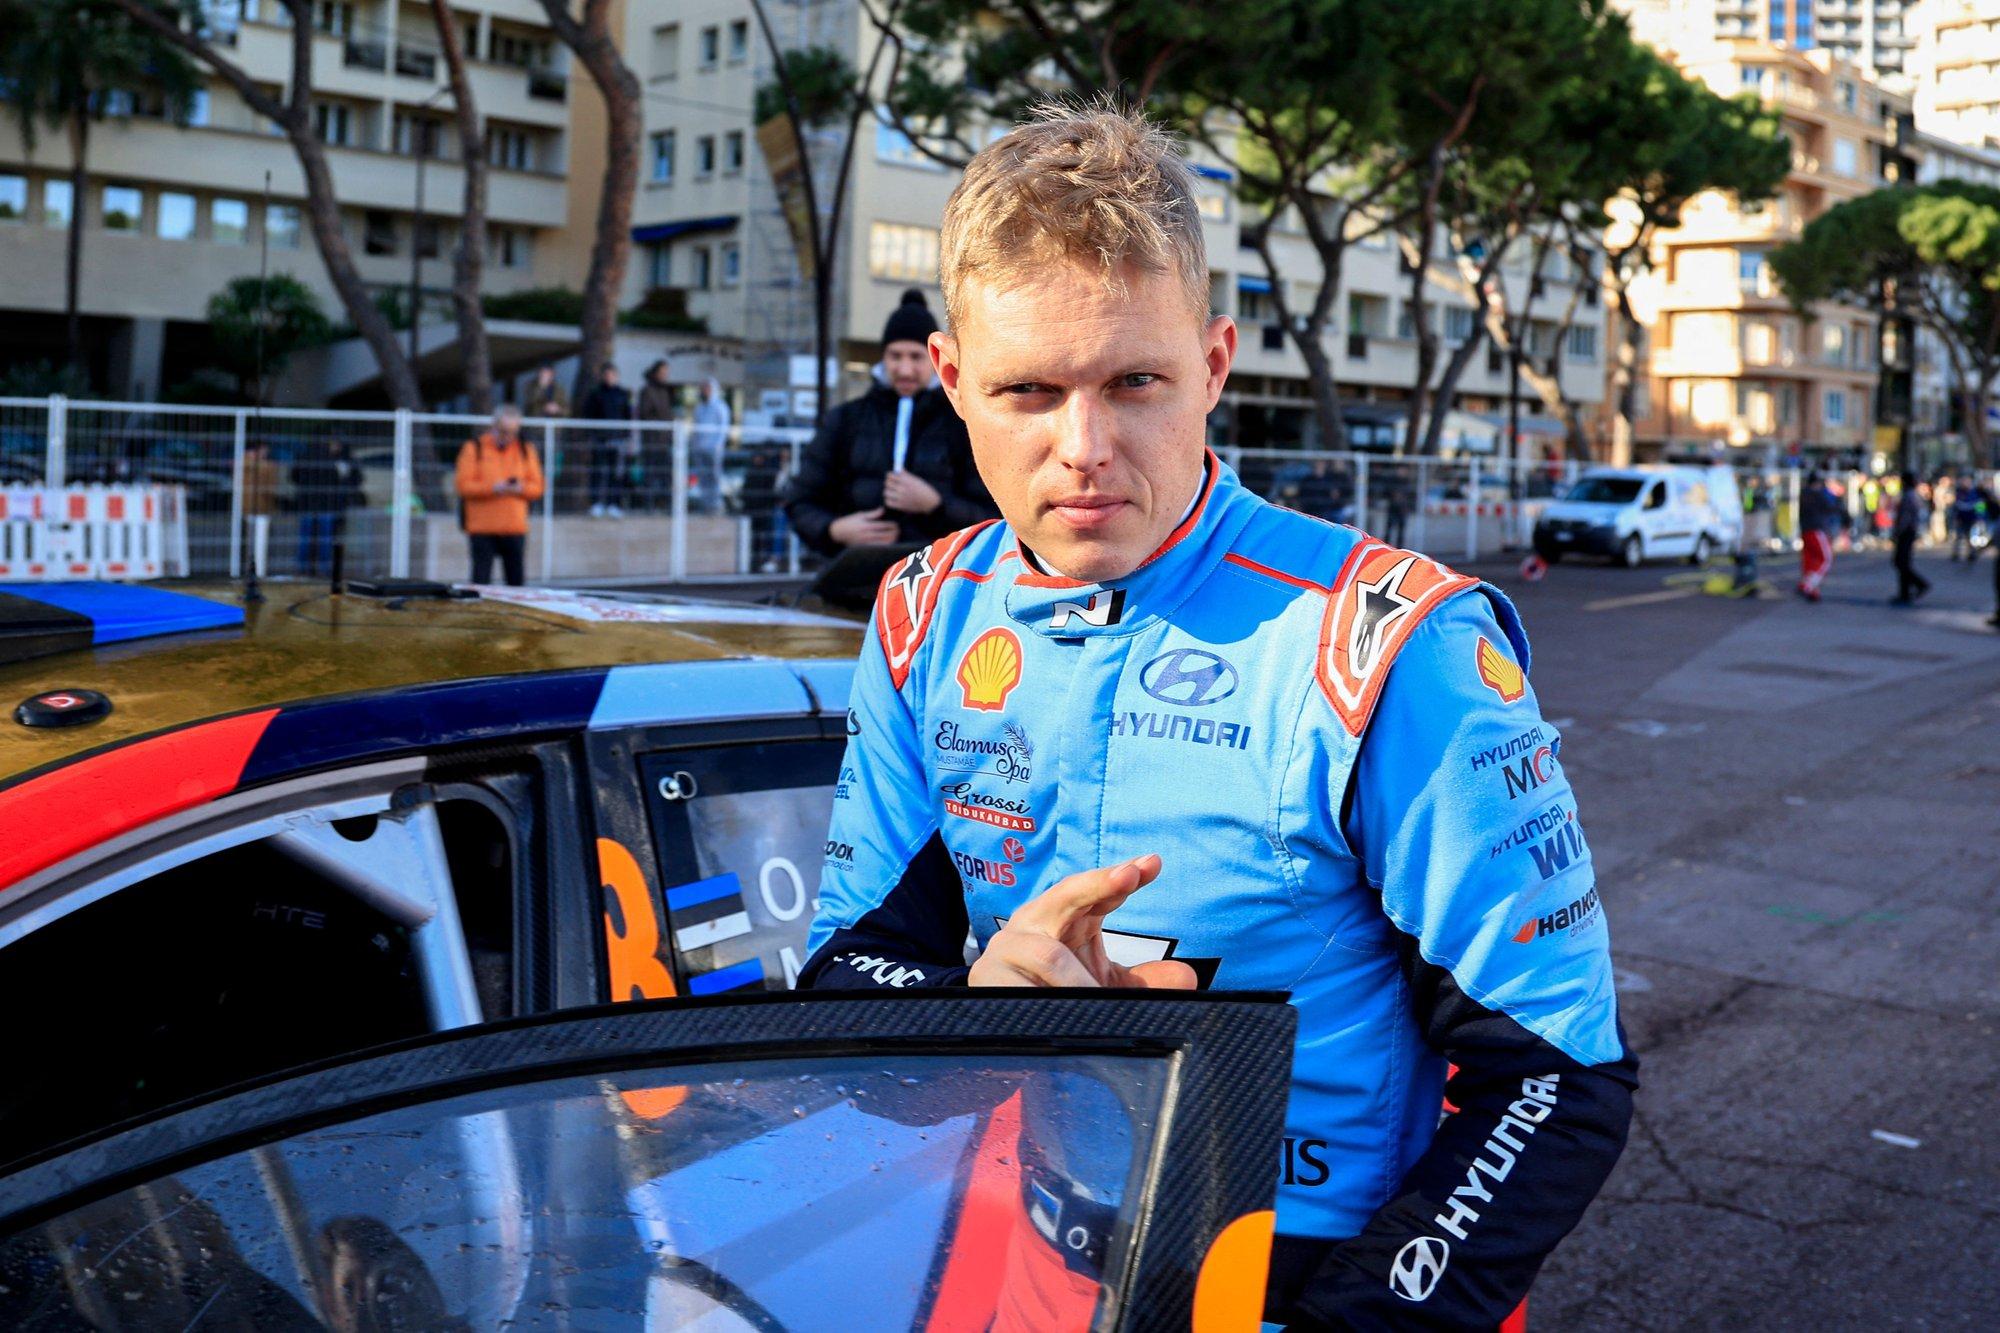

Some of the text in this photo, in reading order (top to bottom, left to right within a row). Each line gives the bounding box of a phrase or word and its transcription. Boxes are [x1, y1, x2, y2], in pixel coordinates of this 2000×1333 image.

[1111, 712, 1252, 751] HYUNDAI
[1470, 725, 1545, 772] HYUNDAI
[935, 720, 1031, 785] Elamus Spa
[940, 782, 1032, 814] Grossi
[945, 802, 1034, 829] TOIDUKAUBAD
[1491, 803, 1566, 860] HYUNDAI
[953, 851, 1017, 887] FORUS
